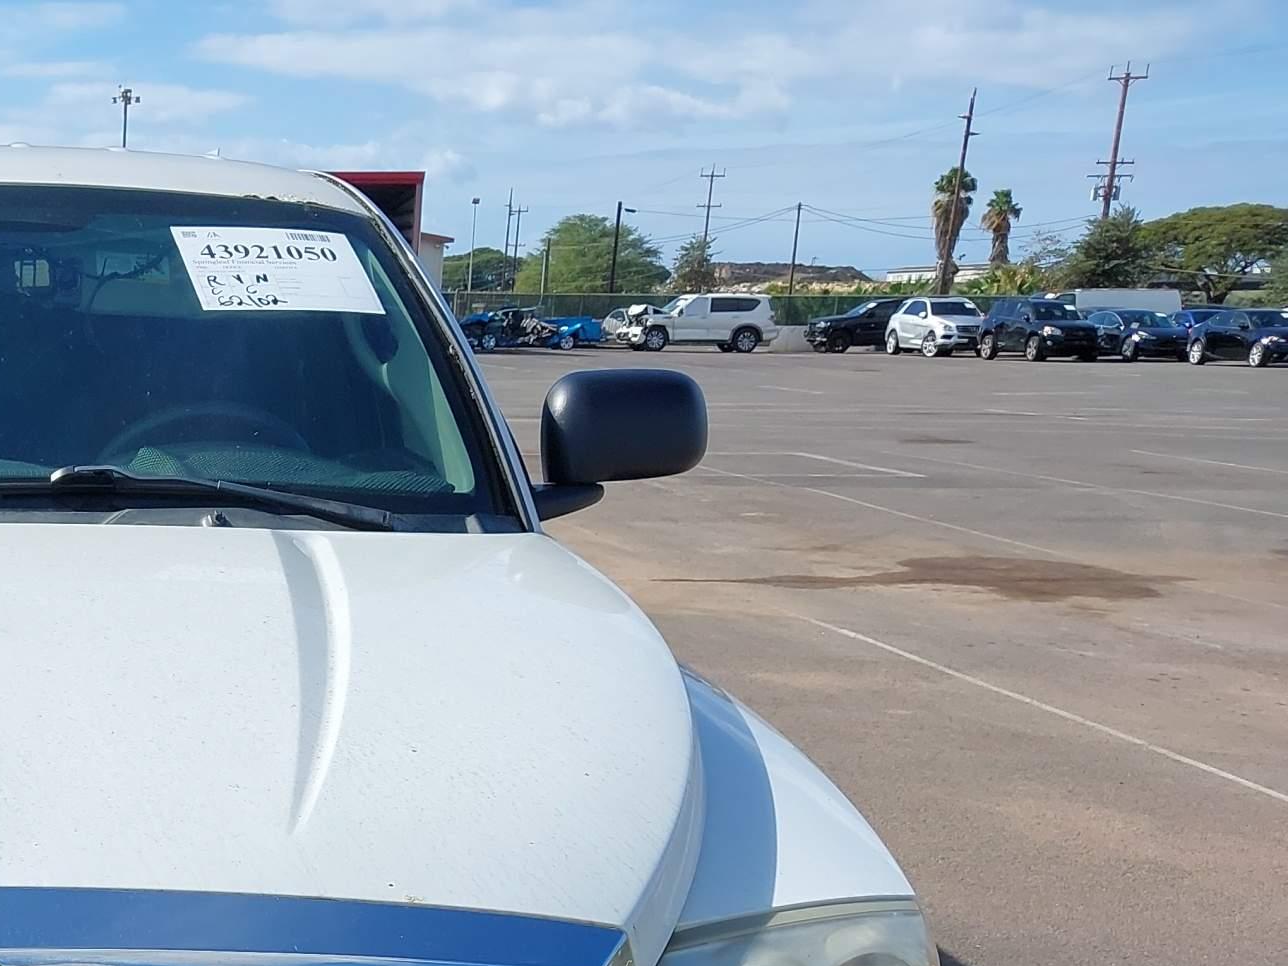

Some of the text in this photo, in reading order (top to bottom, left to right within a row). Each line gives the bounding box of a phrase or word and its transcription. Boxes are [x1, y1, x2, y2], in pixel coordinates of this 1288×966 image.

[200, 243, 337, 262] 43921050
[206, 275, 226, 288] R
[255, 273, 269, 283] N
